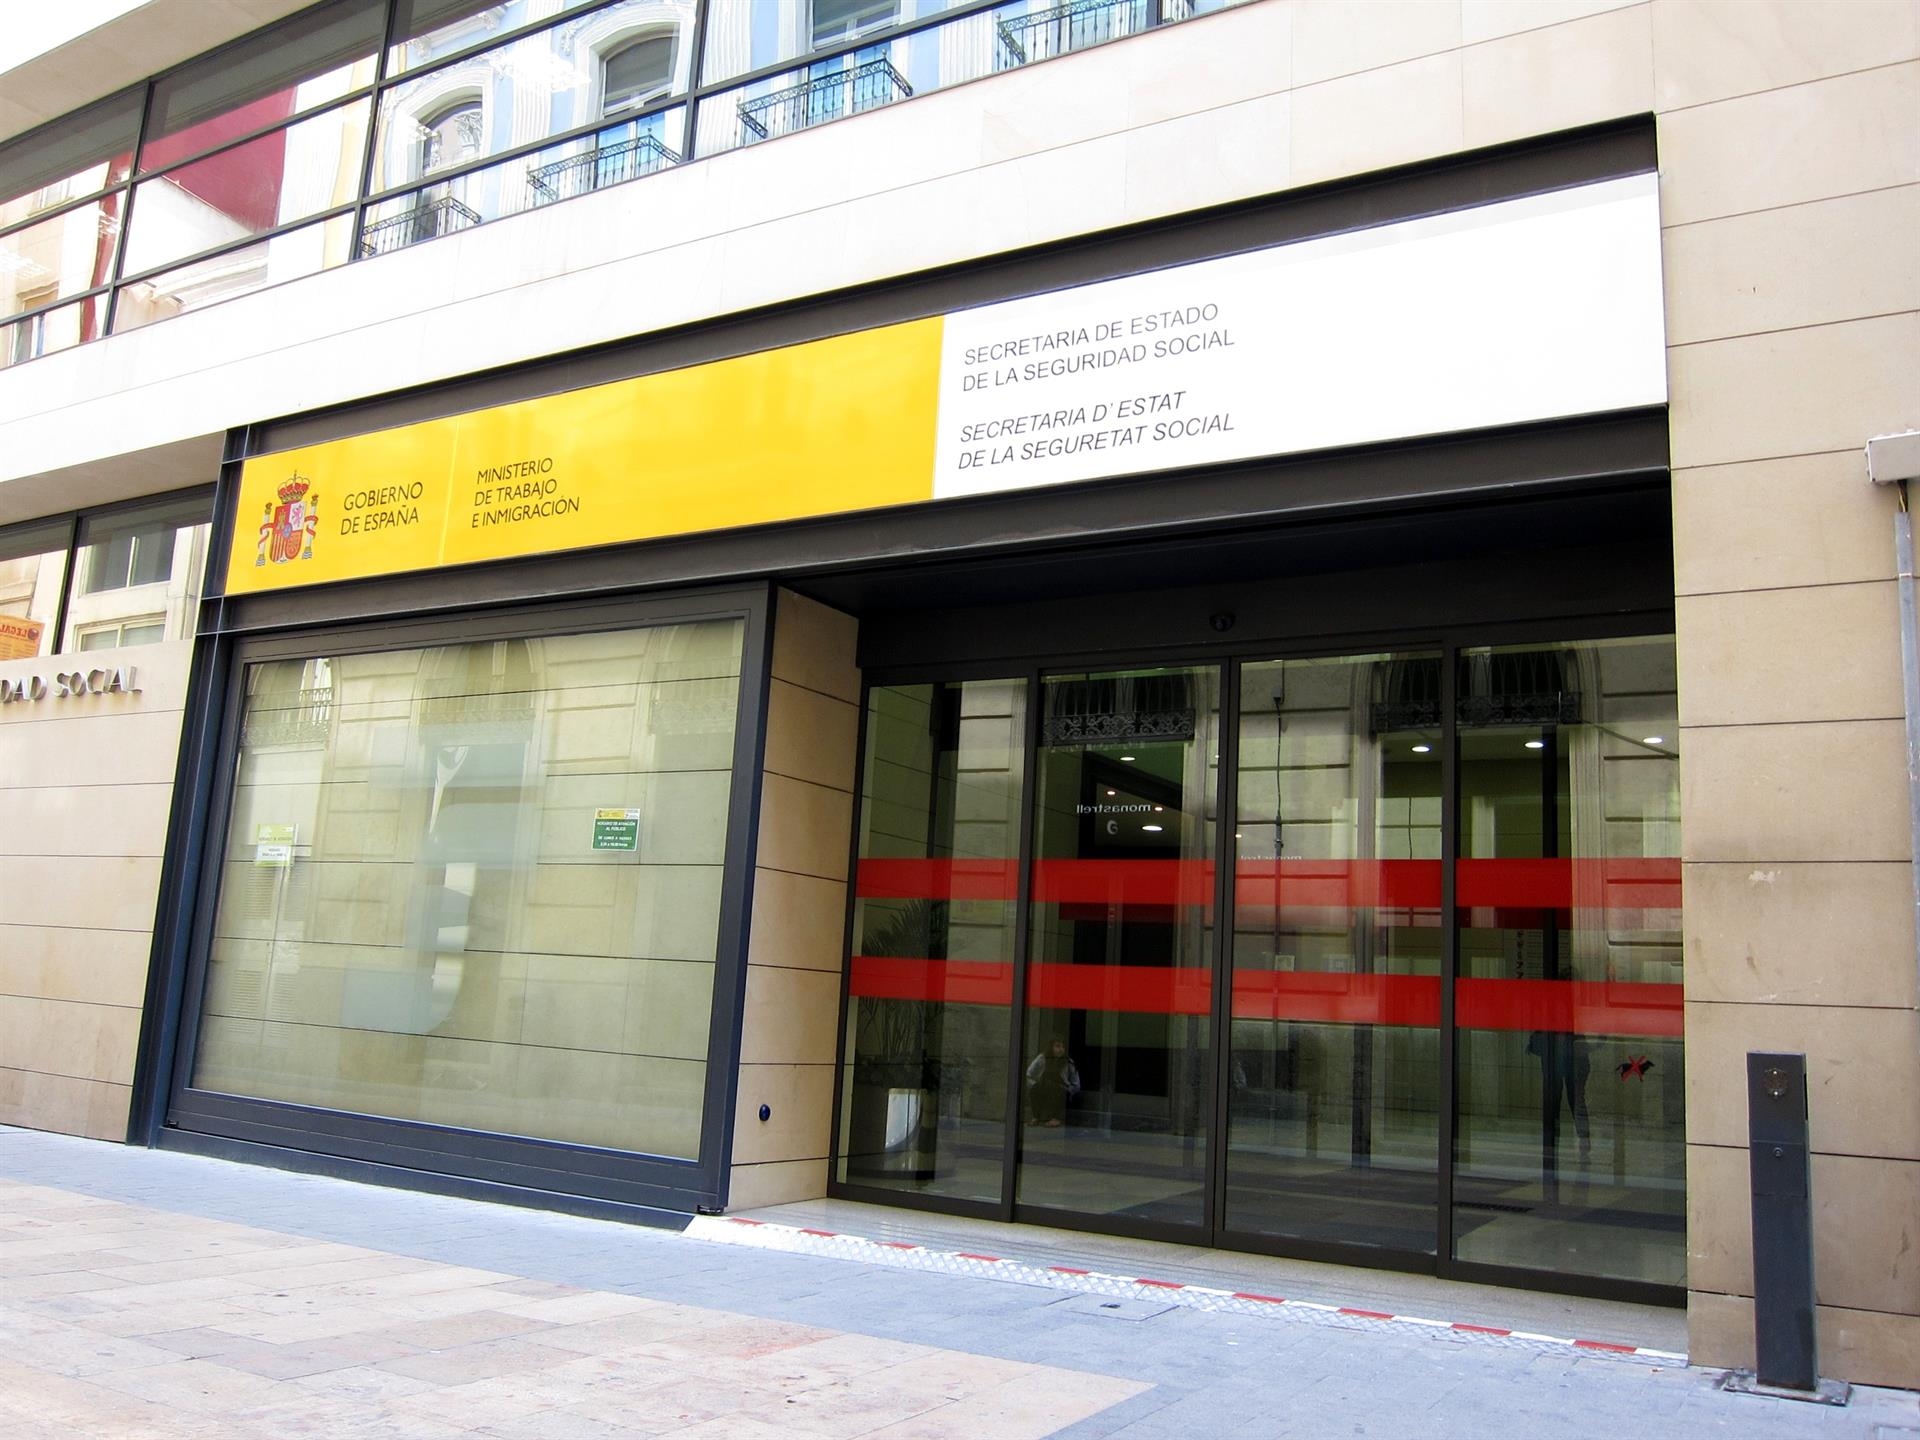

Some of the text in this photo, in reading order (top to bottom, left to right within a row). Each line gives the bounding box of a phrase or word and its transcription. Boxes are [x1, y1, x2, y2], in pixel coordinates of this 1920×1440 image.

[964, 303, 1219, 366] SECRETARIA DE ESTADO
[963, 329, 1235, 392] DE LA SEGURIDAD SOCIAL
[960, 407, 1086, 443] SECRETARIA
[1117, 390, 1187, 419] ESTAT
[958, 413, 1235, 470] DE LA SEGURETAT SOCIAL
[476, 457, 553, 485] MINISTERIO
[343, 481, 424, 512] GOBIERNO
[474, 478, 558, 507] DE TRABAJO
[341, 504, 419, 535] DE ESPAÑA
[472, 495, 580, 528] E INMIGRACIÓN
[53, 666, 143, 698] SOCIAL
